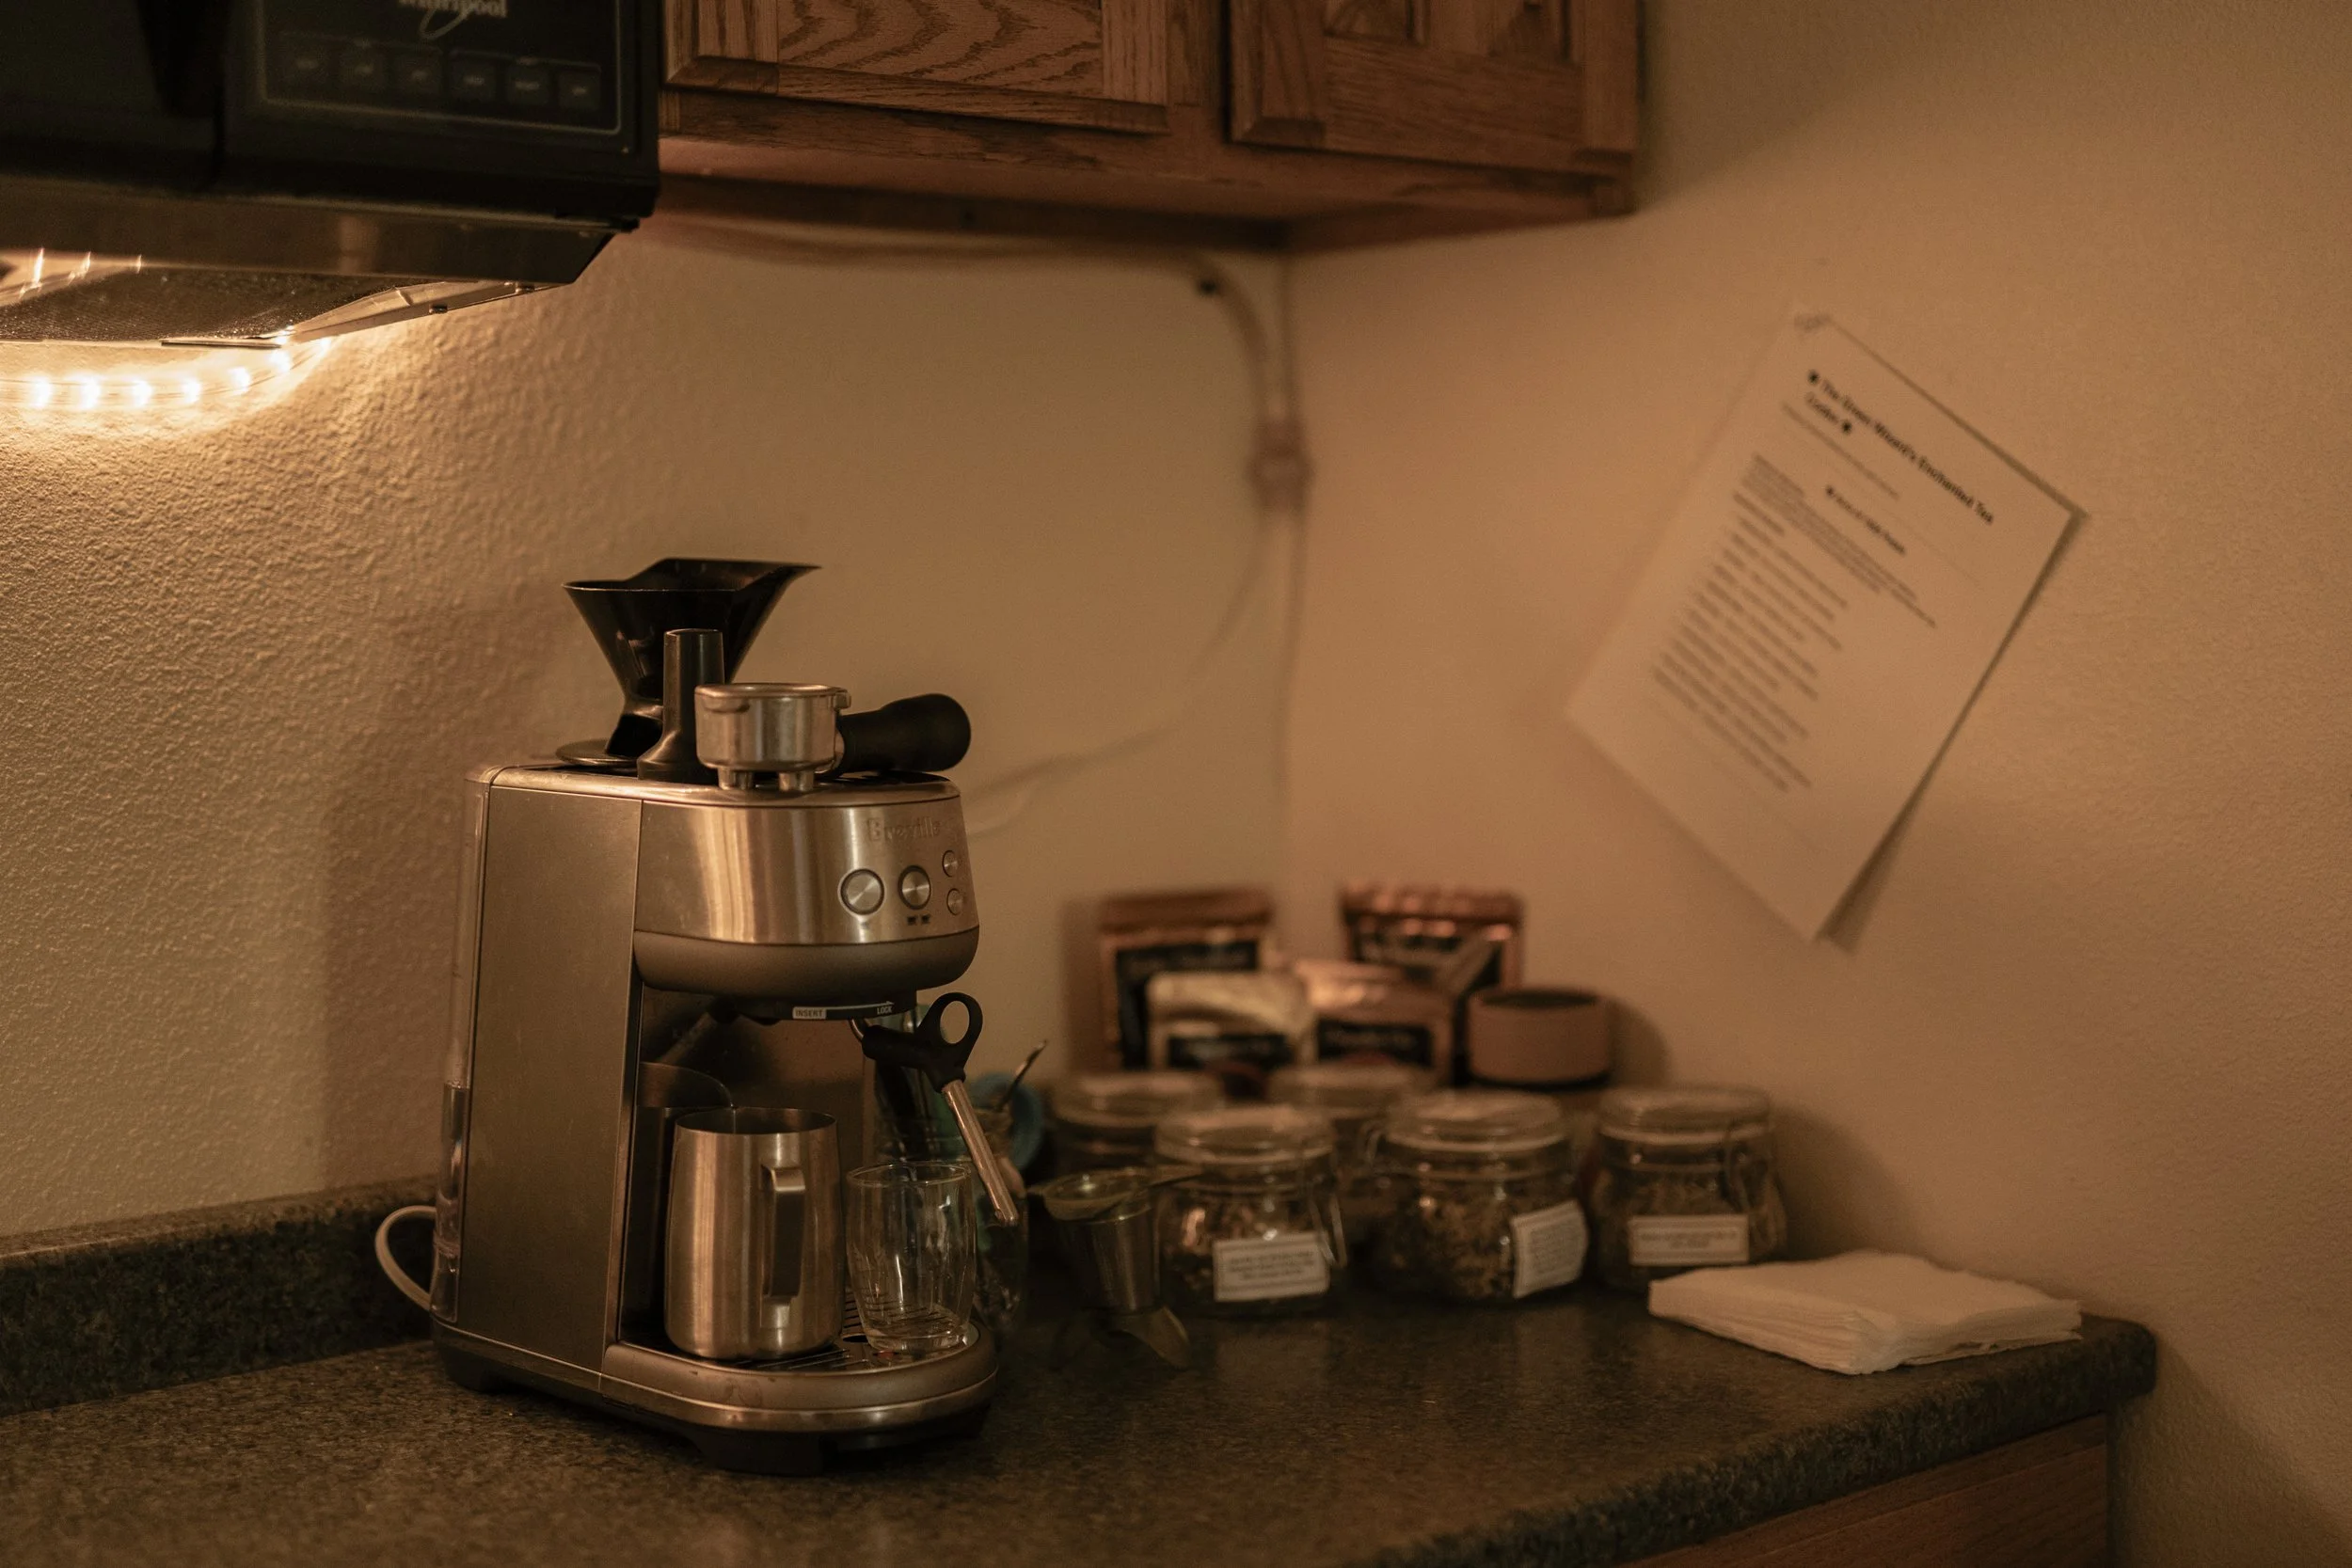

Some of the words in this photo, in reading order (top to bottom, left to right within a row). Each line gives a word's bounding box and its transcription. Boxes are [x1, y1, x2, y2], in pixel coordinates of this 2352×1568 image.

[398, 0, 507, 18] irlpool
[866, 816, 941, 841] Breville
[794, 1007, 823, 1018] INSERT
[876, 1006, 893, 1016] LOCK
